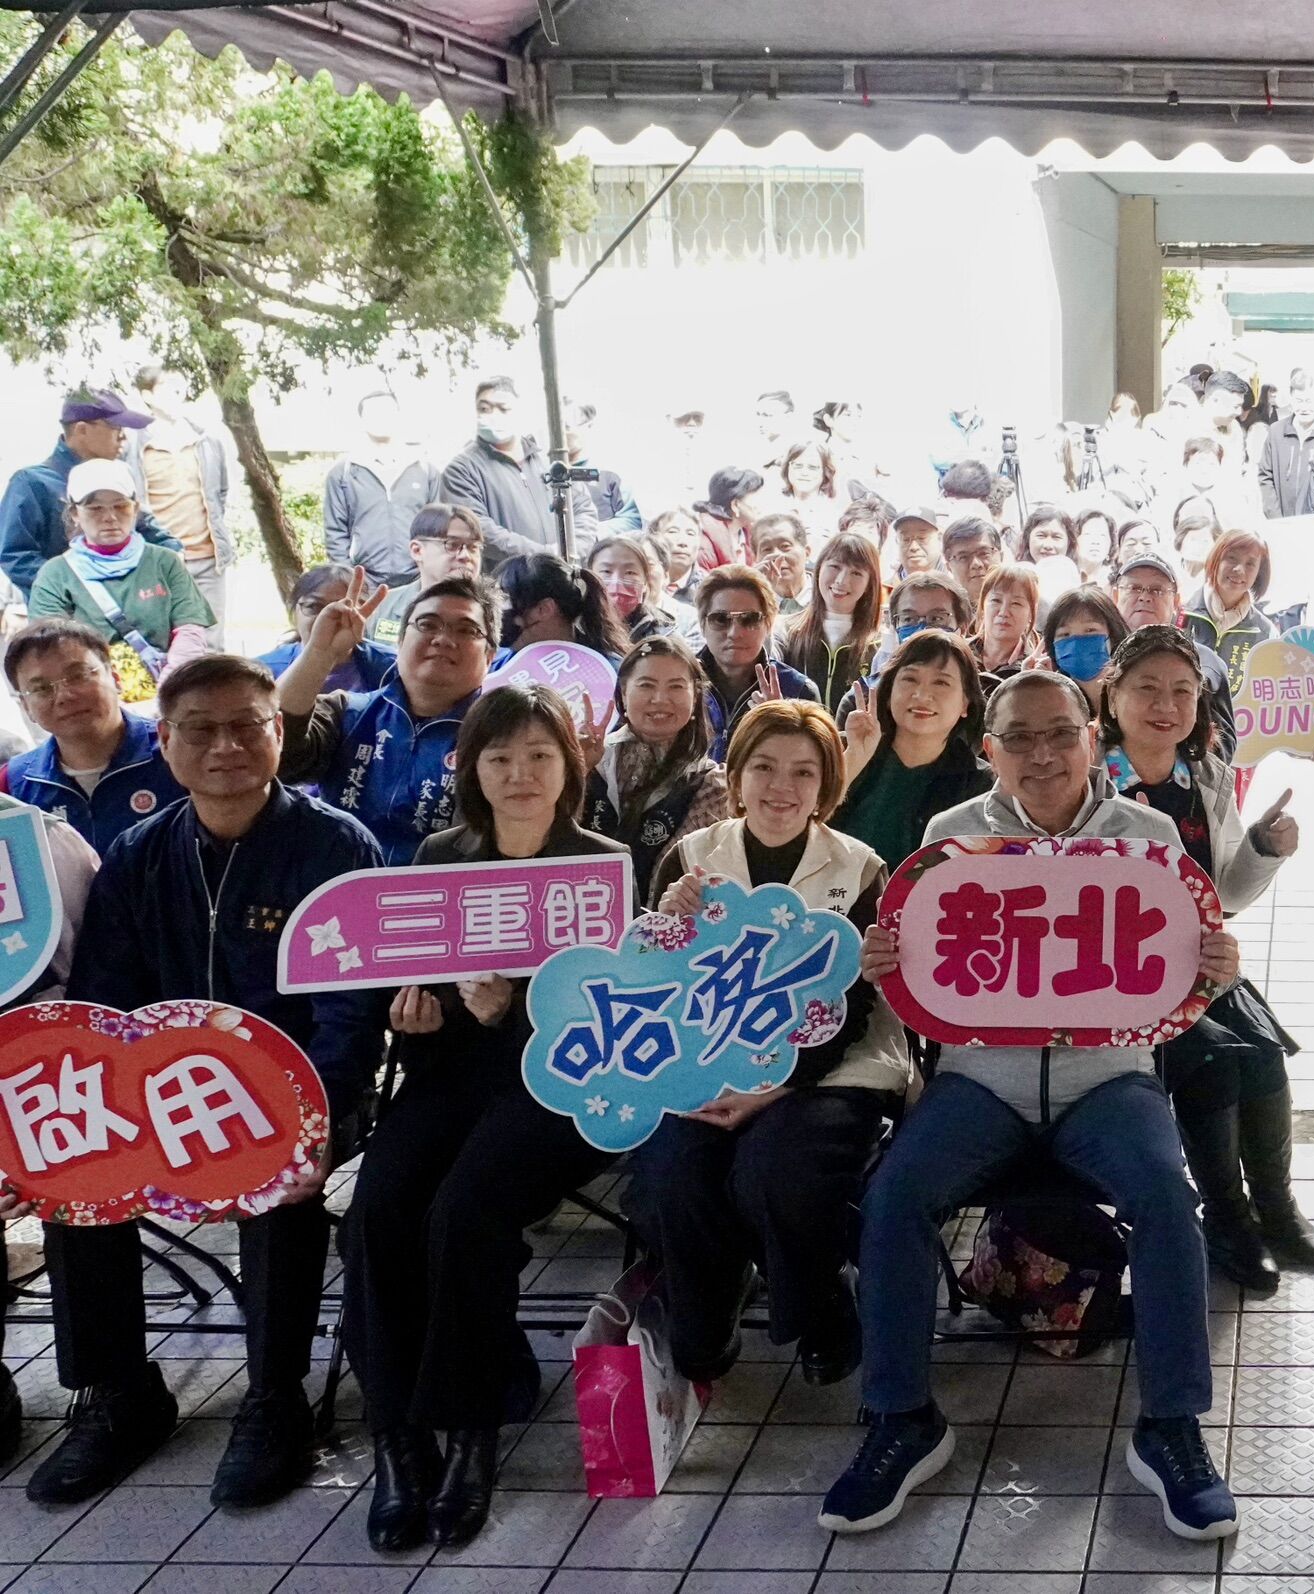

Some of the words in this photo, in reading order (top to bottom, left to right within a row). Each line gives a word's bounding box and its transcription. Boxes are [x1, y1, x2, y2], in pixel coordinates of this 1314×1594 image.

[374, 878, 613, 957] 三重館
[932, 881, 1167, 998] 新北
[548, 929, 836, 1082] 哈客
